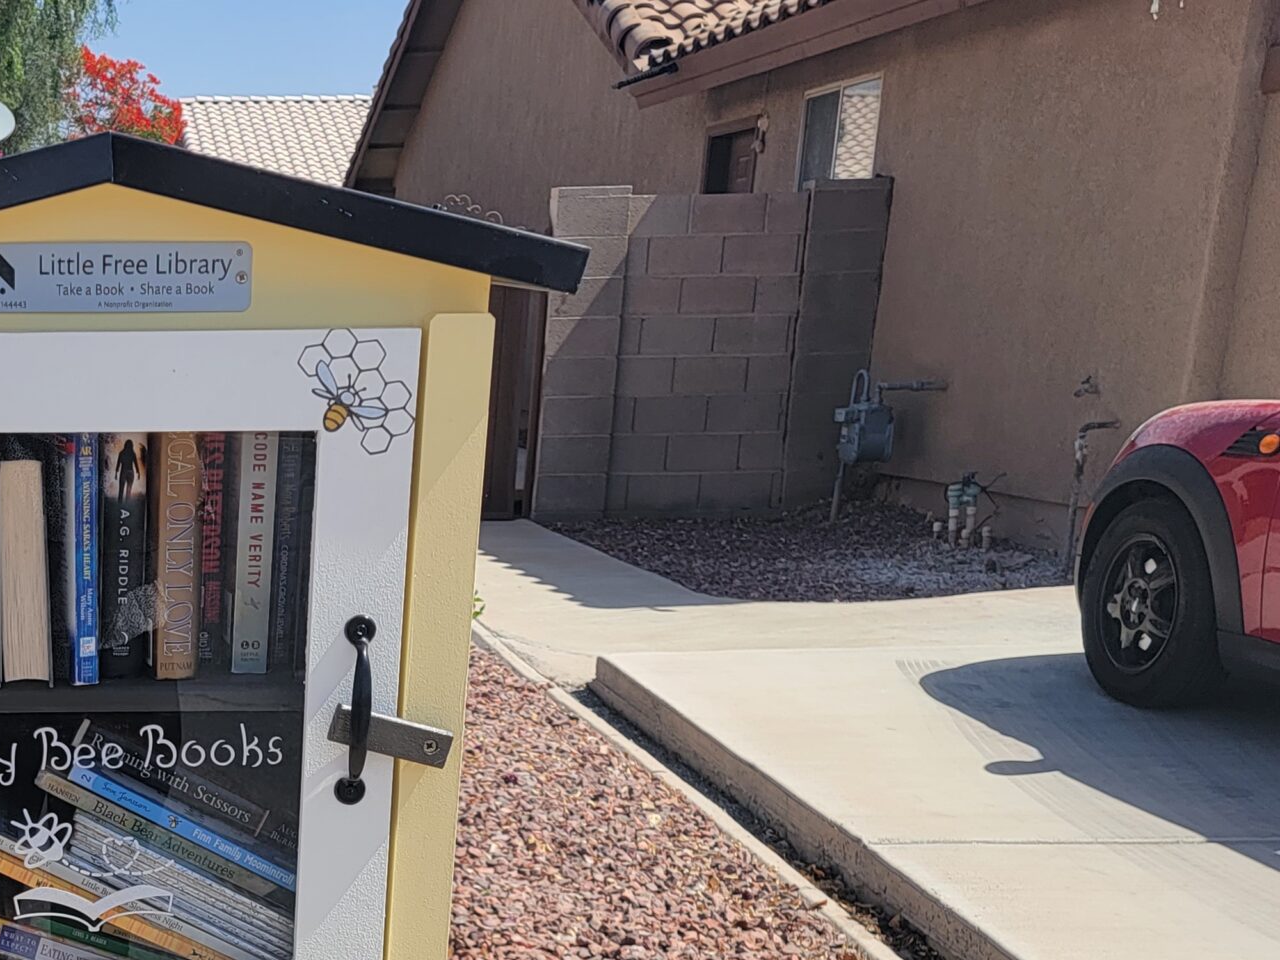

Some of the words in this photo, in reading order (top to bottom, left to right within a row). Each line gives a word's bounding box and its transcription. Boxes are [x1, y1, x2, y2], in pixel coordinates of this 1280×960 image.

[38, 252, 95, 276] Little
[101, 254, 148, 275] Free
[155, 250, 234, 281] Library
[55, 283, 83, 296] Take
[85, 286, 92, 296] a
[95, 283, 125, 296] Book
[139, 282, 173, 296] Share
[175, 285, 182, 295] a
[185, 282, 215, 295] Book
[103, 300, 133, 309] Nonprofit
[252, 432, 268, 473] CODE
[82, 481, 91, 523] WINNING
[250, 482, 266, 525] NAME
[166, 501, 195, 577] ONLY
[82, 554, 92, 581] HEART
[118, 549, 129, 605] RIDDLE
[247, 533, 263, 589] VERITY
[163, 583, 194, 657] LOVE
[160, 661, 193, 671] PUTNAM
[33, 726, 123, 770] Bee
[139, 722, 283, 769] Books
[47, 782, 81, 803] HANSEN
[157, 770, 190, 793] with
[193, 783, 252, 824] Scissors
[92, 800, 128, 827] Black
[130, 820, 162, 842] Bear
[161, 838, 236, 880] Adventures
[192, 828, 212, 844] Finn
[213, 839, 242, 860] Family
[81, 877, 101, 896] Little
[162, 917, 184, 932] Night
